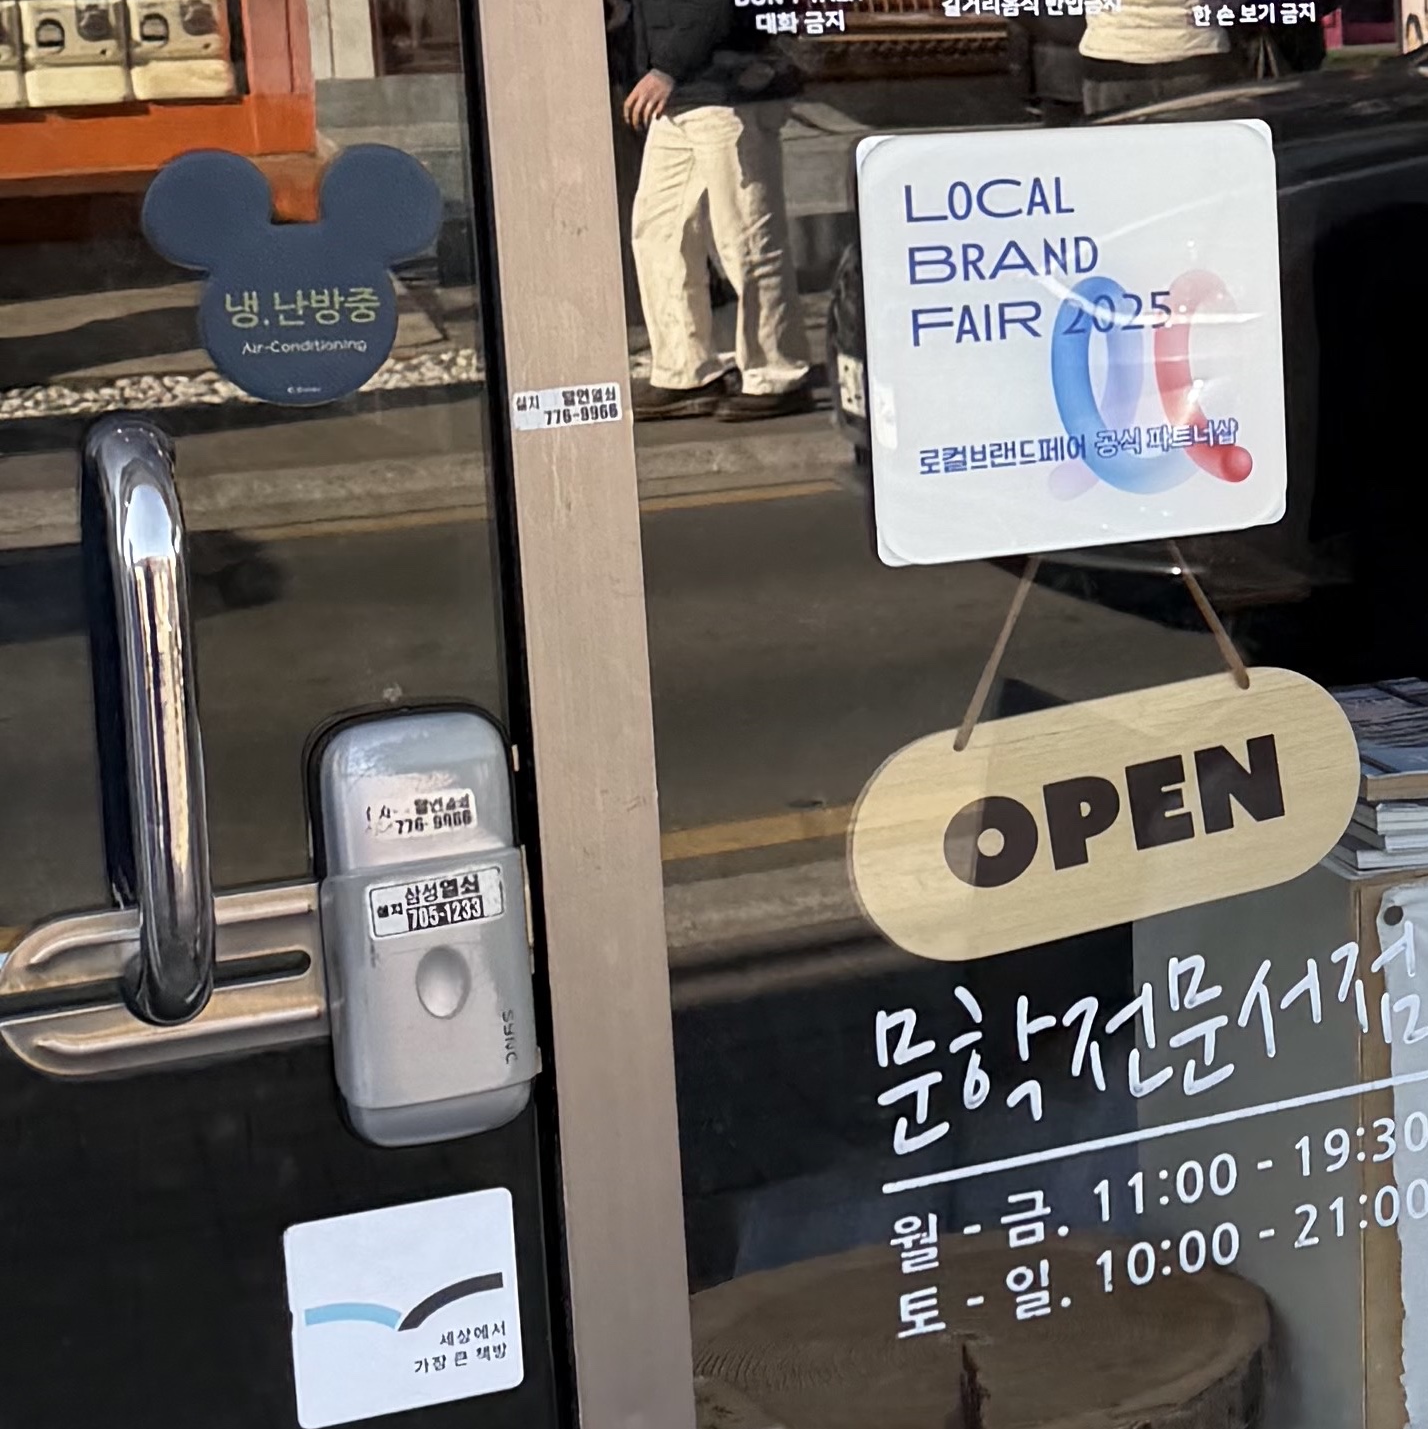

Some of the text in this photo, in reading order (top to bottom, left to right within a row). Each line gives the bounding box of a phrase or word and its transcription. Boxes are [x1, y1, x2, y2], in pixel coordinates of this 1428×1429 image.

[755, 10, 846, 34] 대화 금지
[1192, 2, 1317, 27] 한 손 보기 금지
[902, 176, 1075, 224] LOCAL
[907, 235, 1100, 285] BRAND
[224, 286, 381, 329] 냉.난방중
[910, 289, 1173, 347] FAIR 2025
[241, 340, 368, 356] Air-Conditioning
[919, 418, 1239, 476] 로컬브랜드페어 공식 파트너샵
[942, 732, 1287, 888] OPEN
[404, 873, 481, 906] 삼성열쇠
[408, 897, 483, 931] 705-1233
[889, 1211, 941, 1275] 월
[1093, 1151, 1238, 1223] 11:00
[897, 1286, 947, 1340] 토
[1094, 1220, 1242, 1293] 10:00
[439, 1320, 506, 1347] 세상에서
[414, 1354, 447, 1373] 가장
